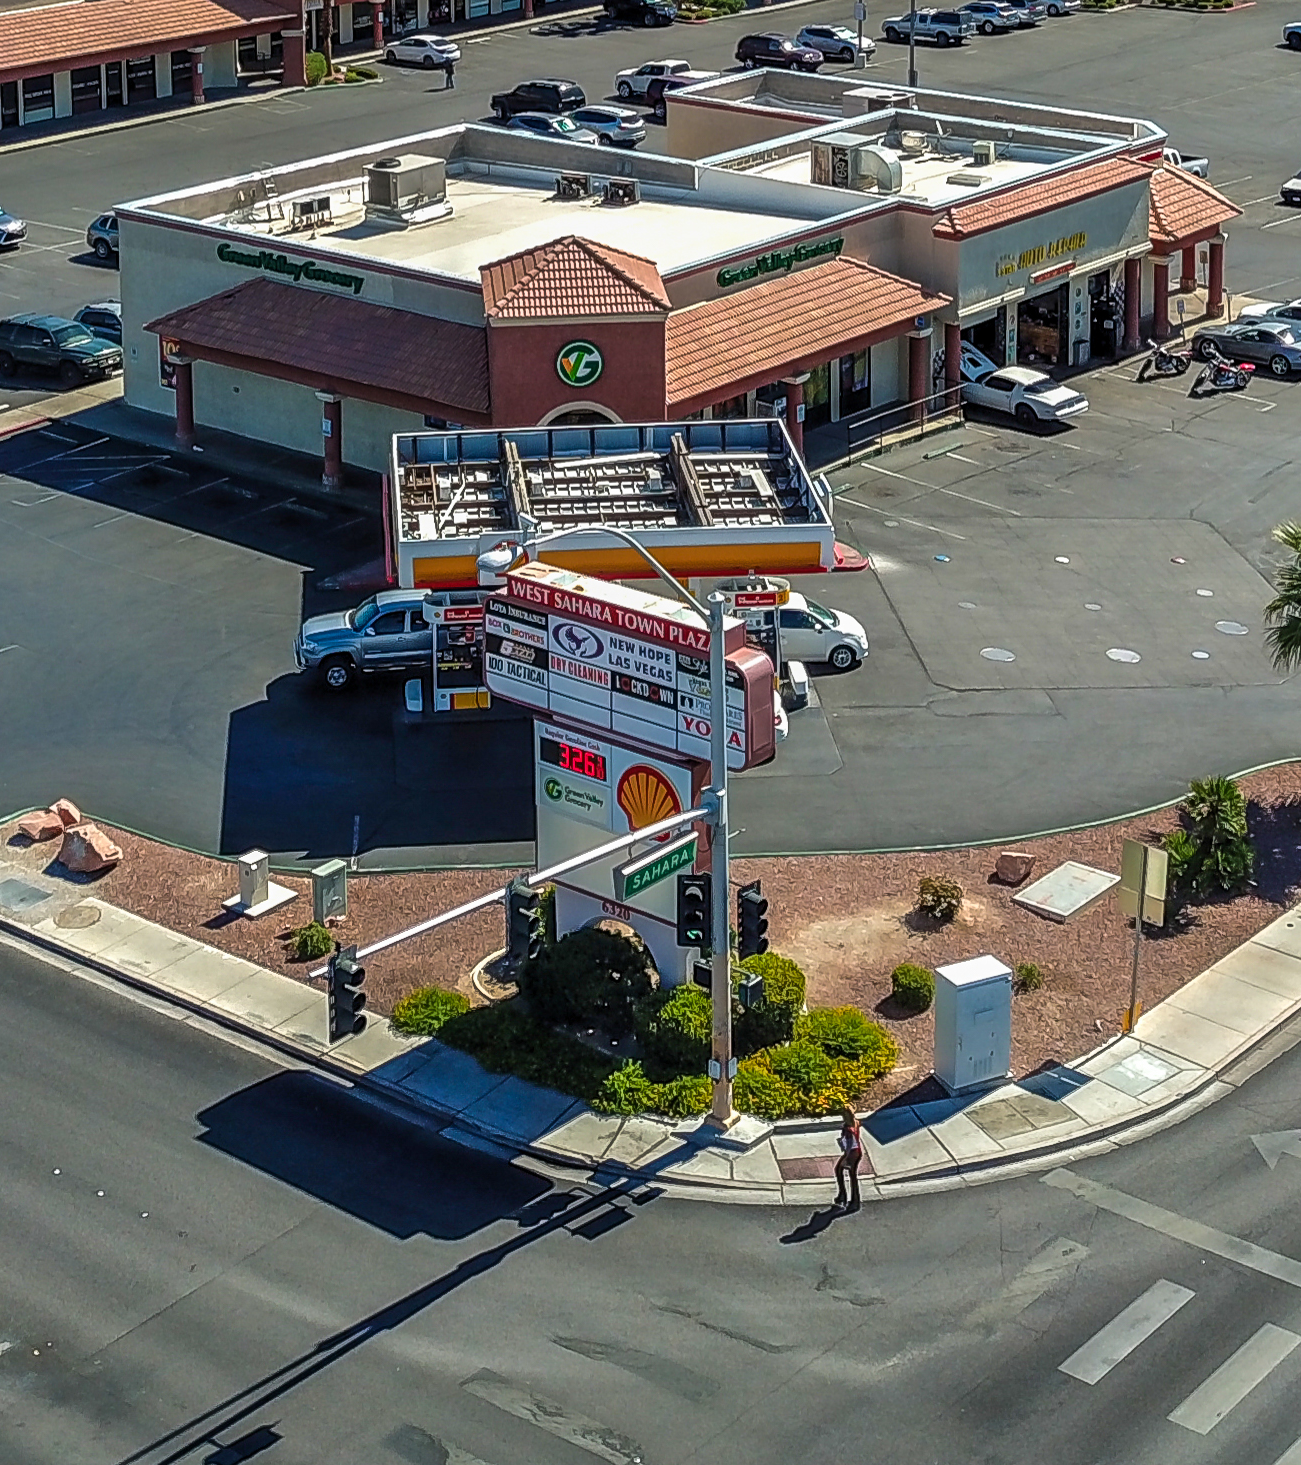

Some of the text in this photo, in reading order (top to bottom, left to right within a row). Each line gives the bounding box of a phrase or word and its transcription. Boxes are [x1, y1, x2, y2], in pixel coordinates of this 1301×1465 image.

[217, 243, 365, 295] Green Valley Grocery
[756, 250, 795, 275] Valley
[1018, 244, 1047, 270] AUTO
[511, 580, 551, 605] WEST
[554, 592, 613, 623] SAHARA
[615, 609, 665, 639] TOWN
[609, 636, 636, 655] NEW
[638, 645, 672, 666] HOPE
[506, 661, 546, 687] TACTICAL
[550, 654, 609, 687] DRY CLEANING
[608, 653, 631, 670] LAS
[633, 660, 673, 683] VEGAS
[616, 674, 674, 705] LOCKDOWN
[682, 716, 742, 747] YOA
[564, 785, 604, 808] Green Valley
[564, 794, 592, 812] Grocery
[632, 849, 689, 890] SAHARA
